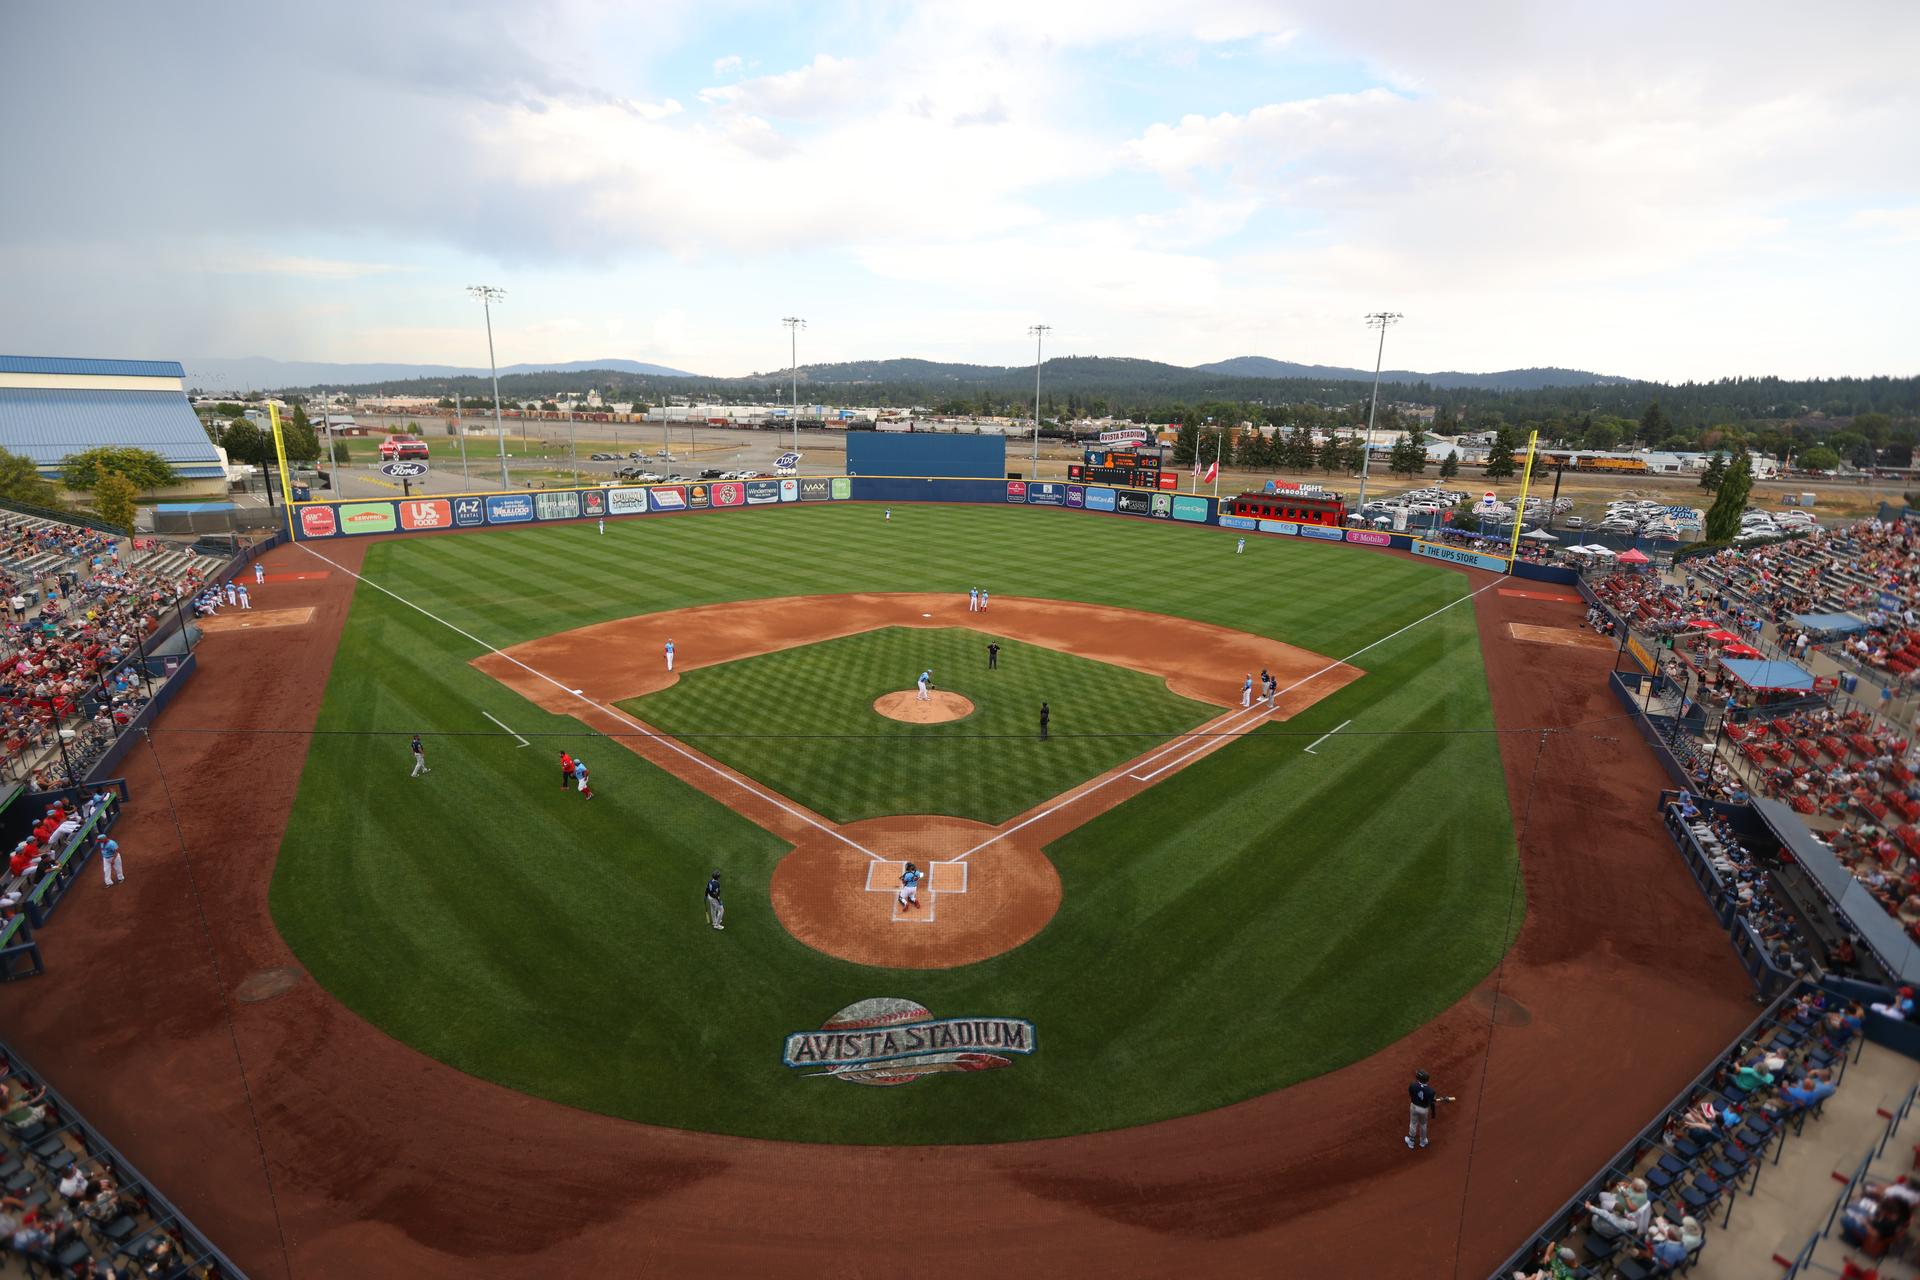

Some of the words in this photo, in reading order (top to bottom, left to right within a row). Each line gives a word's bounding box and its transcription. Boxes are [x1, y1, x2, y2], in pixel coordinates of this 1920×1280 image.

[1100, 432, 1119, 441] AVISTA
[1120, 430, 1145, 440] STADIUM
[781, 456, 793, 464] TDS
[391, 463, 419, 475] Ford
[803, 483, 825, 492] MAX
[1276, 488, 1308, 496] CABOOSE
[1299, 483, 1322, 492] LIGHT
[458, 501, 479, 513] A-Z
[1664, 505, 1691, 514] KIDS
[1671, 511, 1697, 519] ZONE
[414, 518, 438, 527] FOODS
[1359, 534, 1384, 544] Mobile
[1428, 547, 1440, 556] THE
[1441, 549, 1454, 560] UPS
[1457, 552, 1478, 565] STORE
[795, 1031, 898, 1062] AVISTA
[905, 1020, 1026, 1050] STADIUM
